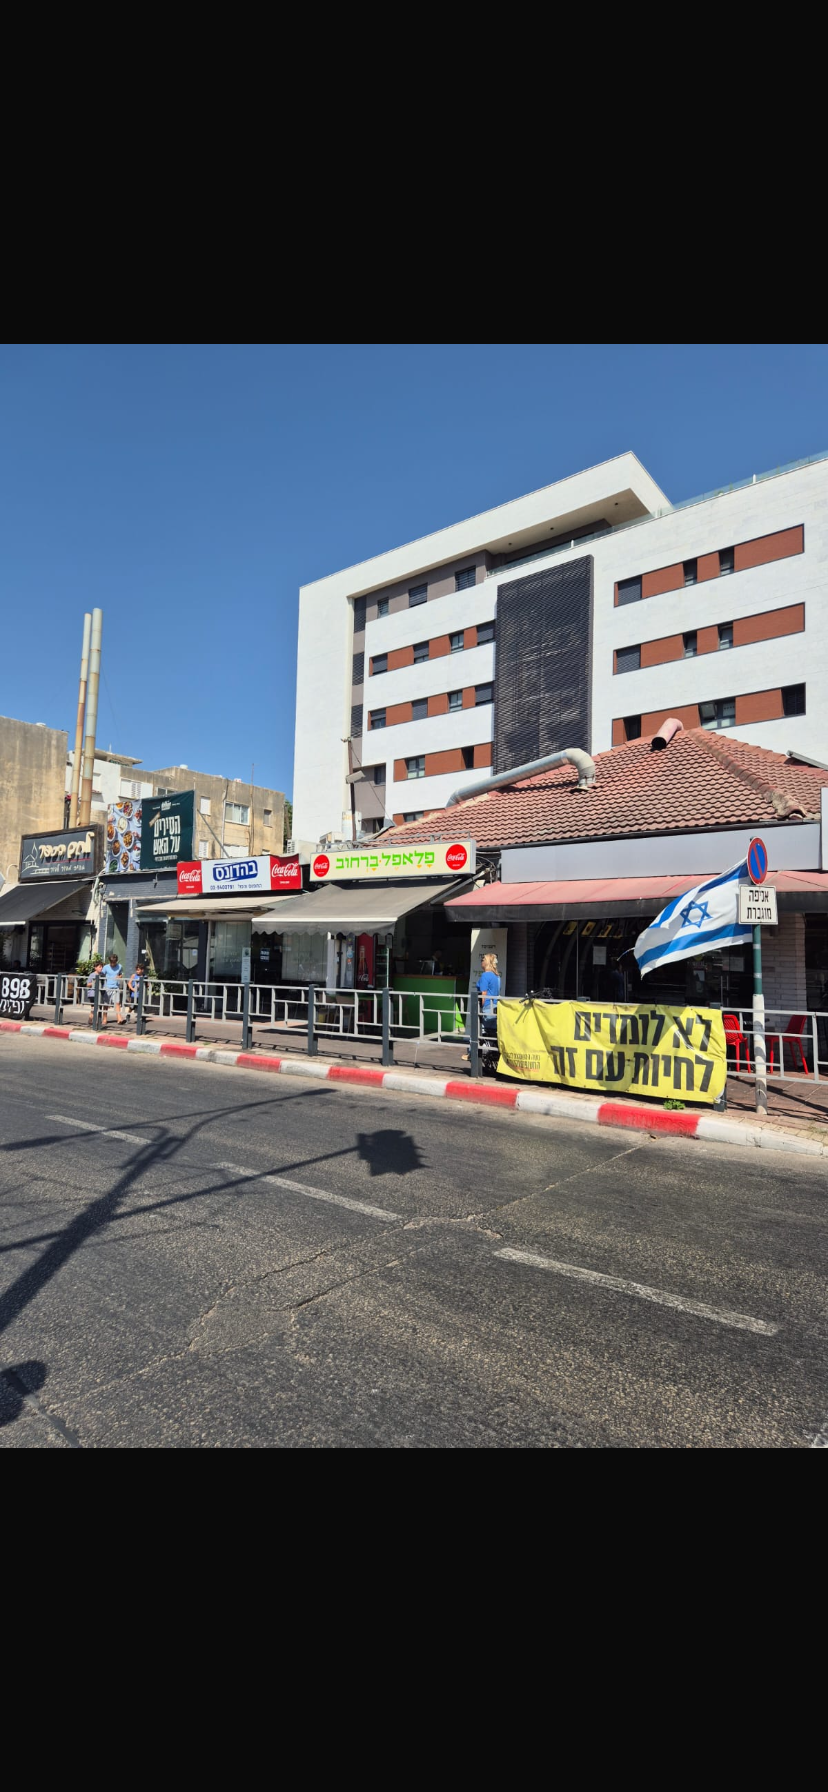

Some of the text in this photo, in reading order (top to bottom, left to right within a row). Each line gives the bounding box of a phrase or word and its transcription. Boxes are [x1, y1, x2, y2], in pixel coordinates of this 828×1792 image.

[153, 815, 180, 837] הסירים
[153, 836, 180, 855] על האש
[749, 890, 769, 902] אכיפה
[747, 907, 772, 919] מוגברת
[2, 977, 30, 999] 898
[574, 1010, 712, 1052] לא לומדים
[550, 1045, 715, 1093] לחיות עם זה
